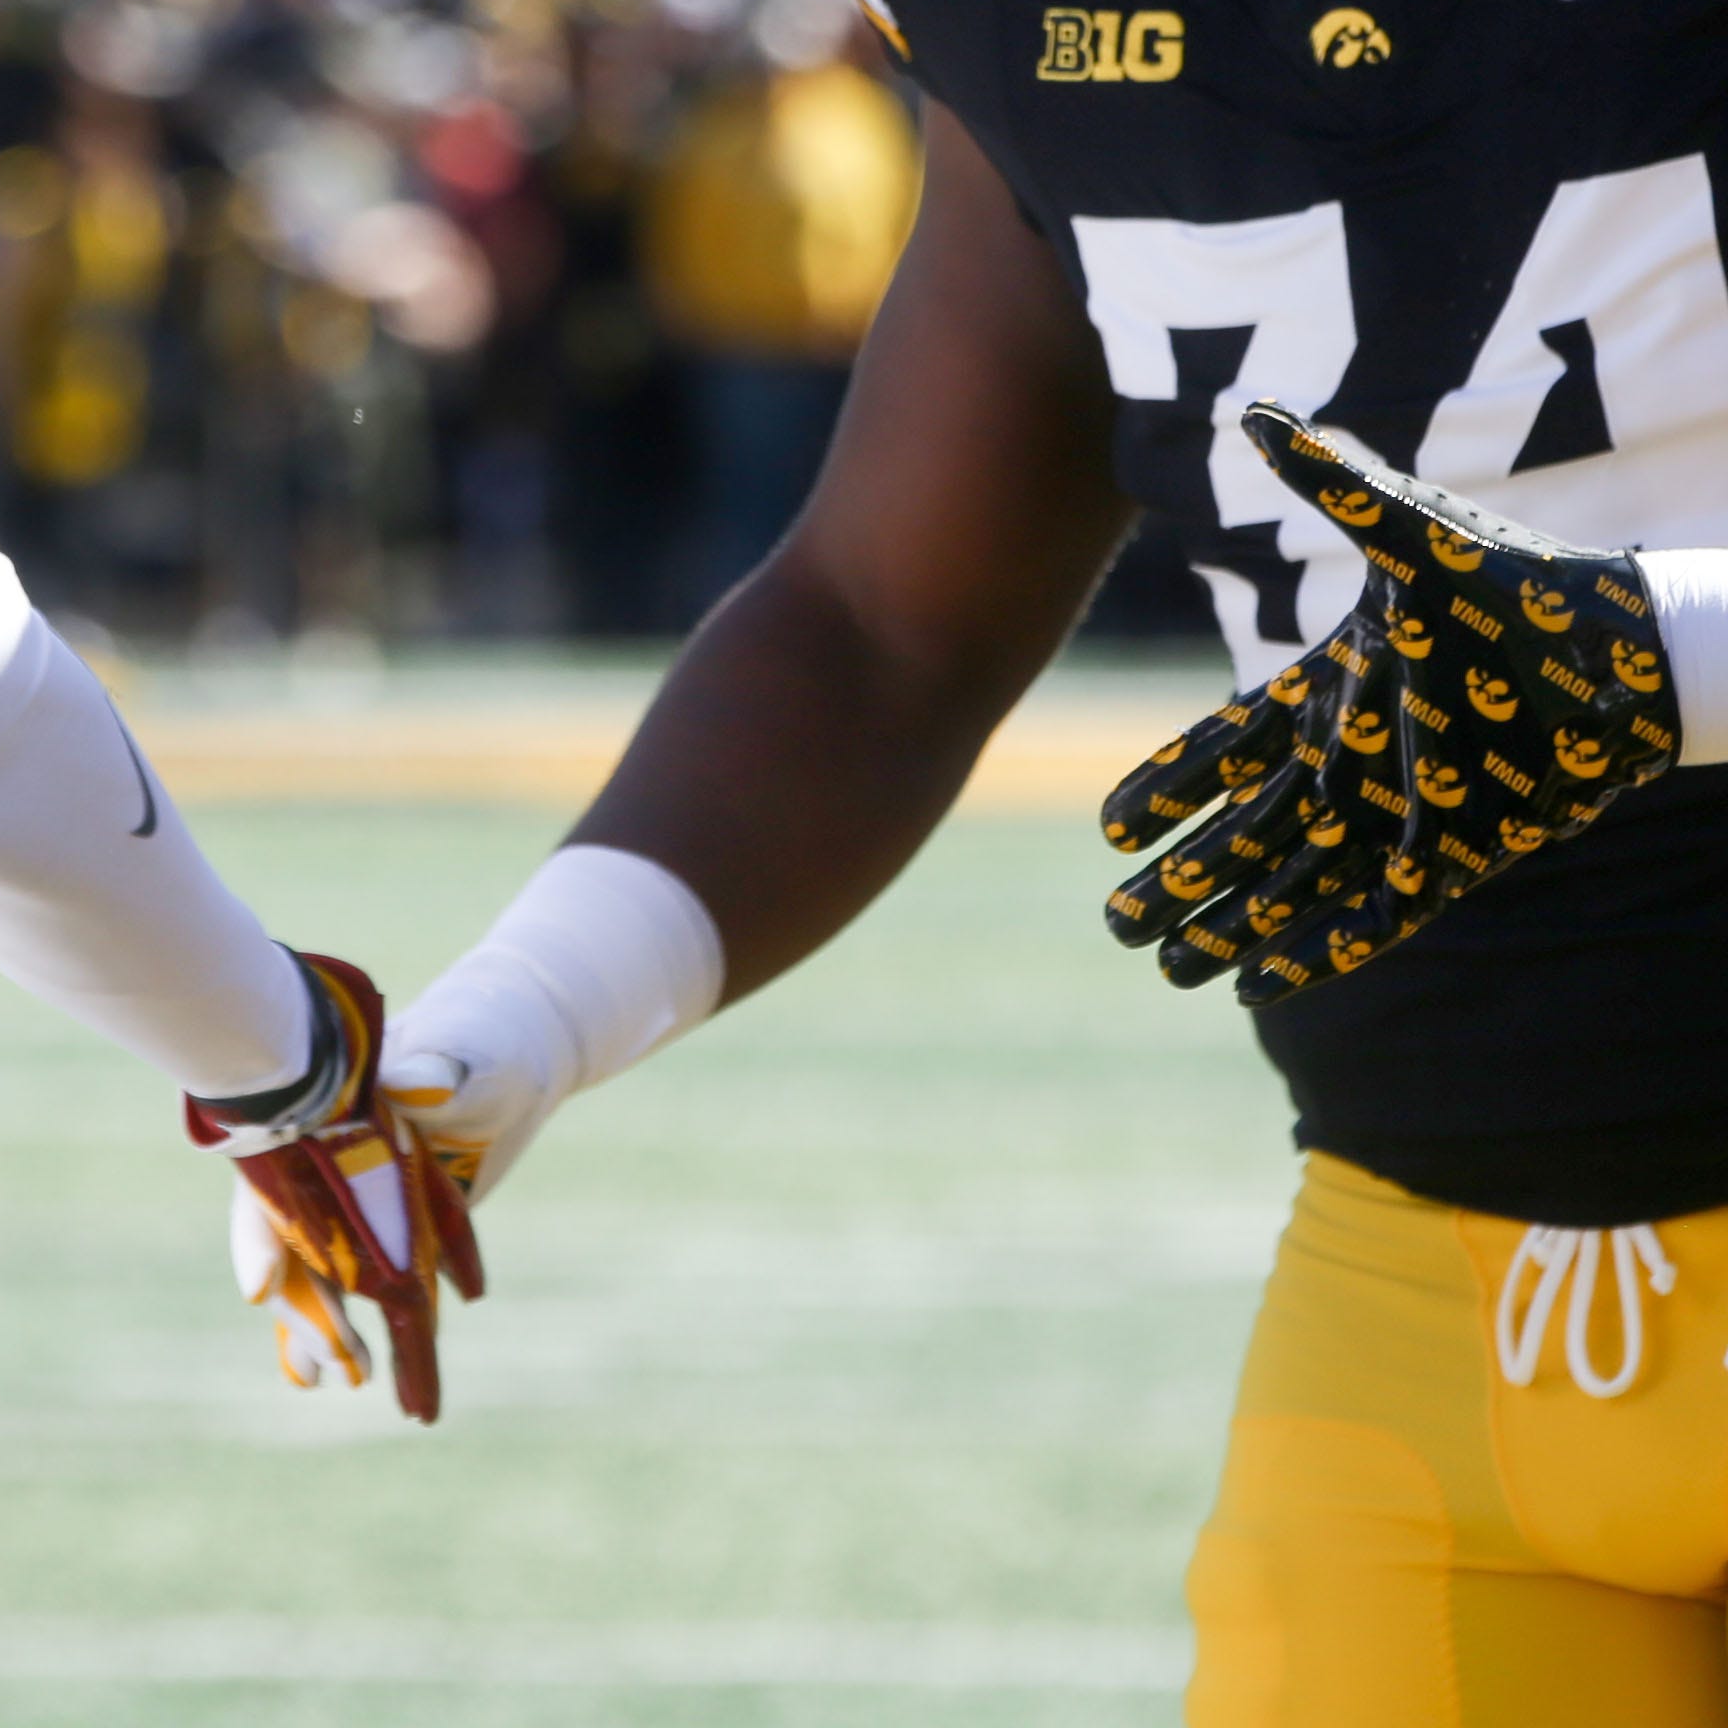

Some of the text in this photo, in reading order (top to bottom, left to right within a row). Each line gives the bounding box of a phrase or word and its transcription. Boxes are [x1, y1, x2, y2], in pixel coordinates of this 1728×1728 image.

[1364, 544, 1418, 587] IOWA
[1449, 594, 1505, 642] IOWA
[1594, 574, 1649, 619] IOWA
[1325, 637, 1372, 679] IOWA
[1539, 656, 1597, 704] IOWA
[1400, 685, 1451, 734] IOWA
[1482, 750, 1537, 799] IOWA
[1359, 777, 1413, 819] IOWA
[1438, 832, 1490, 874] IOWA
[1182, 924, 1238, 960] IOWA
